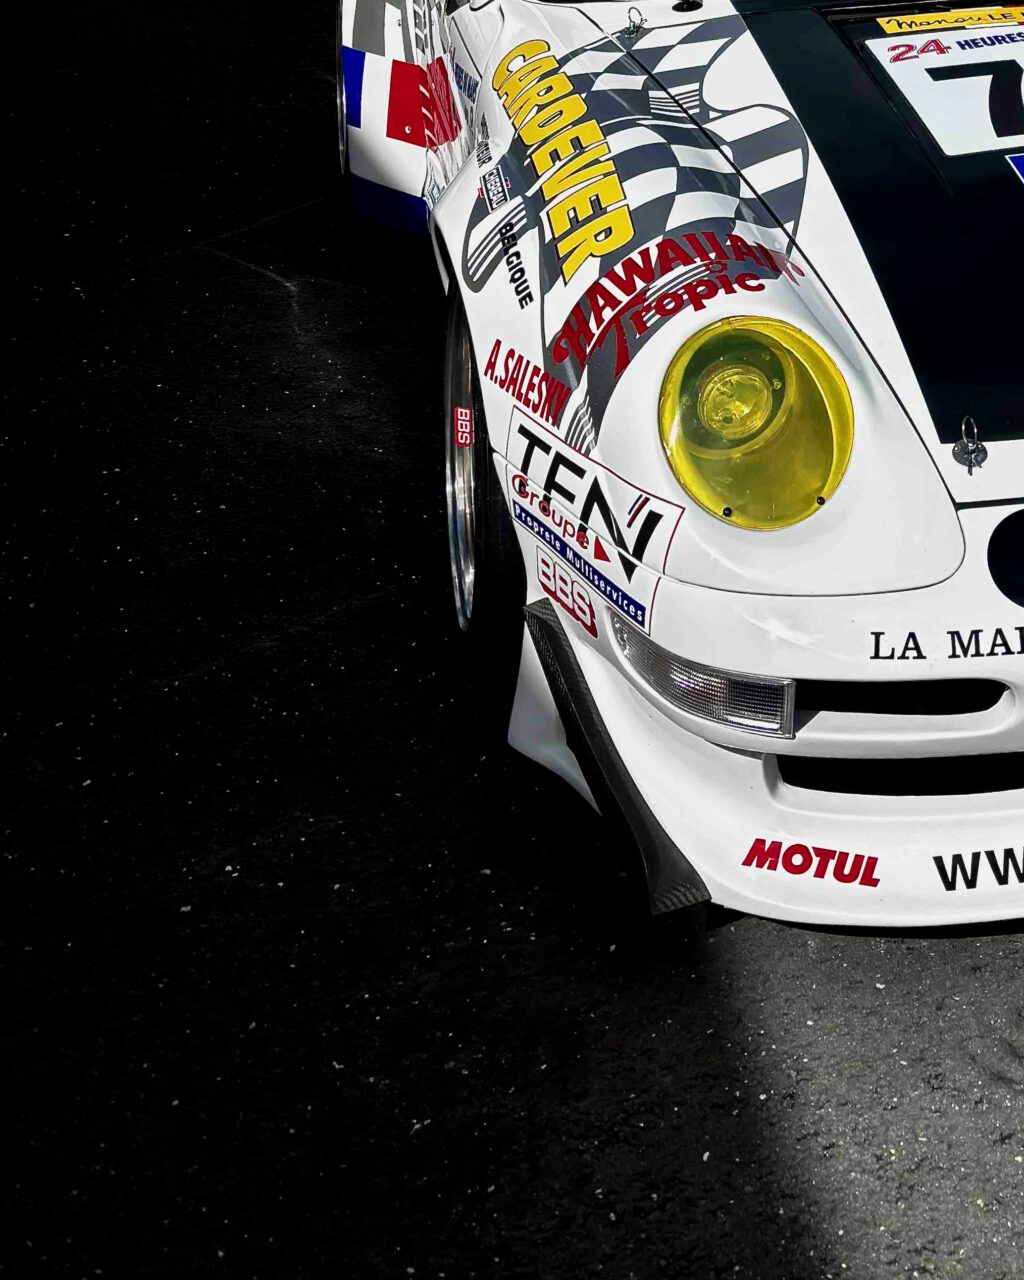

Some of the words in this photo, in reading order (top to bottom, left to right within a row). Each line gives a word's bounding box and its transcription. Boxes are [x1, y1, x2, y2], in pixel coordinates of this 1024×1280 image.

[987, 12, 1014, 21] LE
[888, 38, 951, 64] 24
[486, 169, 507, 210] CHEREAU
[498, 222, 534, 310] BELGIQUE
[552, 231, 805, 368] HAWAIIAN
[588, 272, 766, 378] Tropic
[457, 408, 471, 444] BBS
[511, 474, 590, 550] Groupe
[536, 545, 598, 639] BBS
[567, 550, 644, 622] Multiservices
[870, 631, 926, 660] LA
[741, 837, 881, 888] MOTUL
